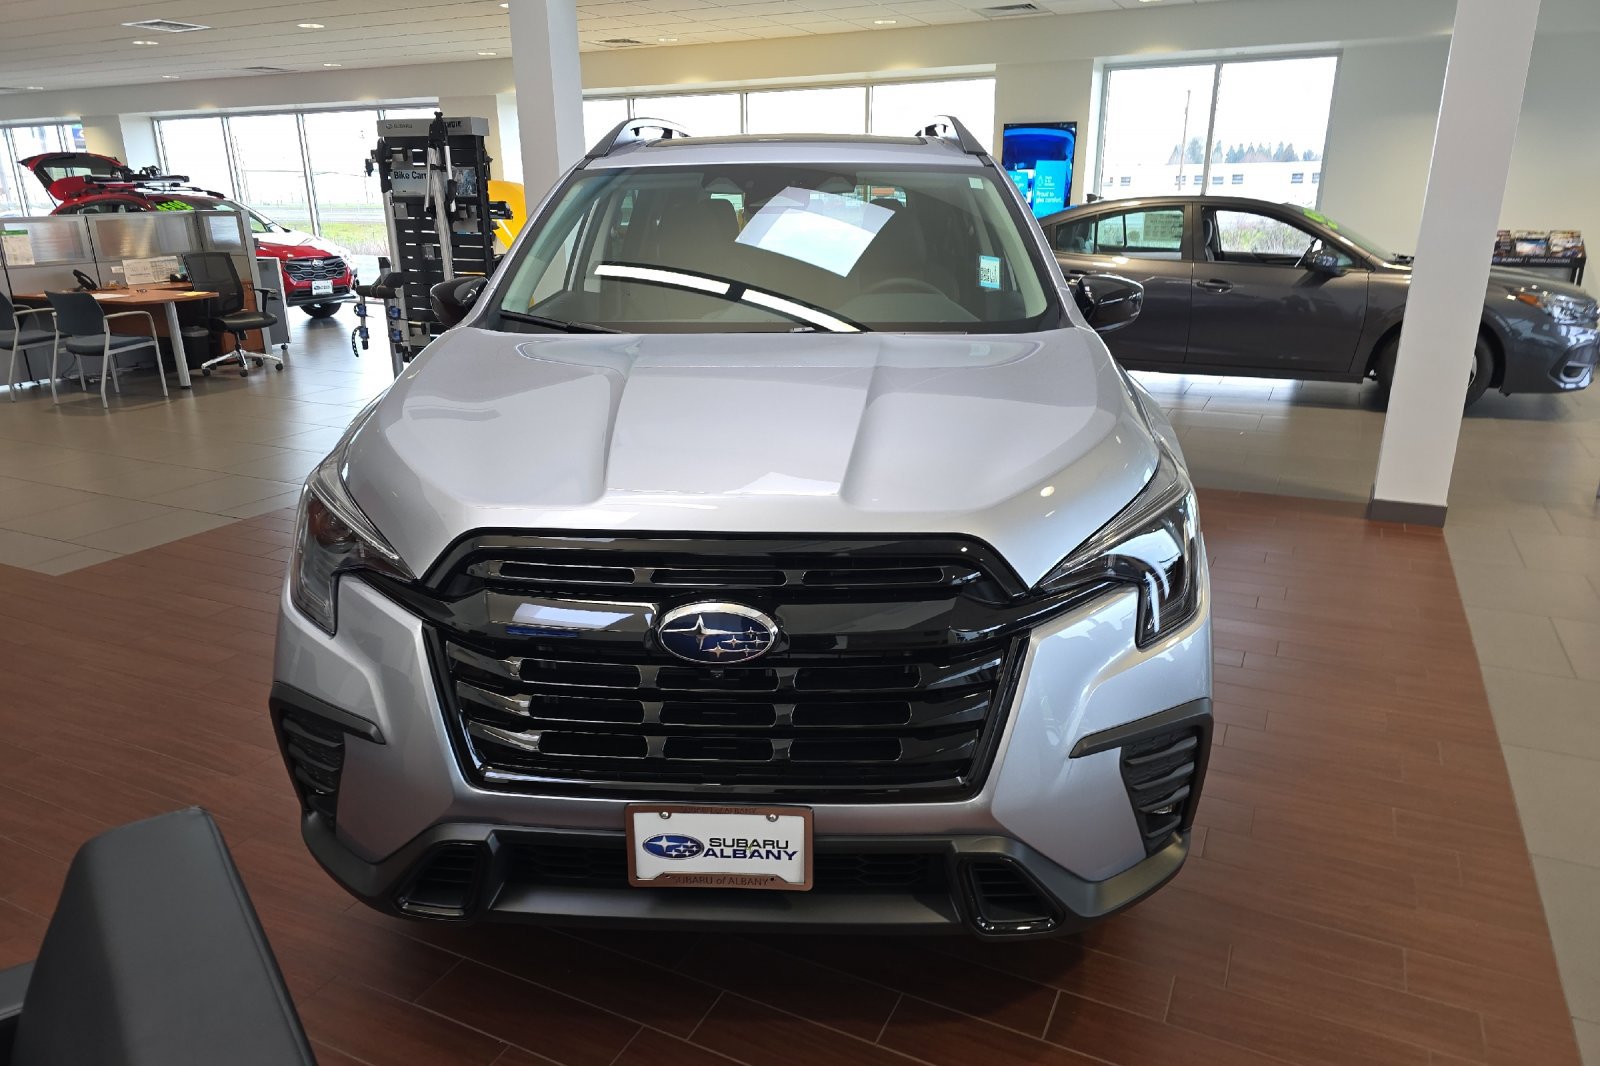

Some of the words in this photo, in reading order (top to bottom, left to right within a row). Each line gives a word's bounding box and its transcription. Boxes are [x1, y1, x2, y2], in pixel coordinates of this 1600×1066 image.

[394, 170, 410, 180] Bike
[709, 837, 789, 850] SUBARU
[702, 847, 799, 861] ALBANY
[675, 875, 713, 885] SUBARU
[716, 876, 726, 885] of
[727, 876, 768, 887] ALBANY
